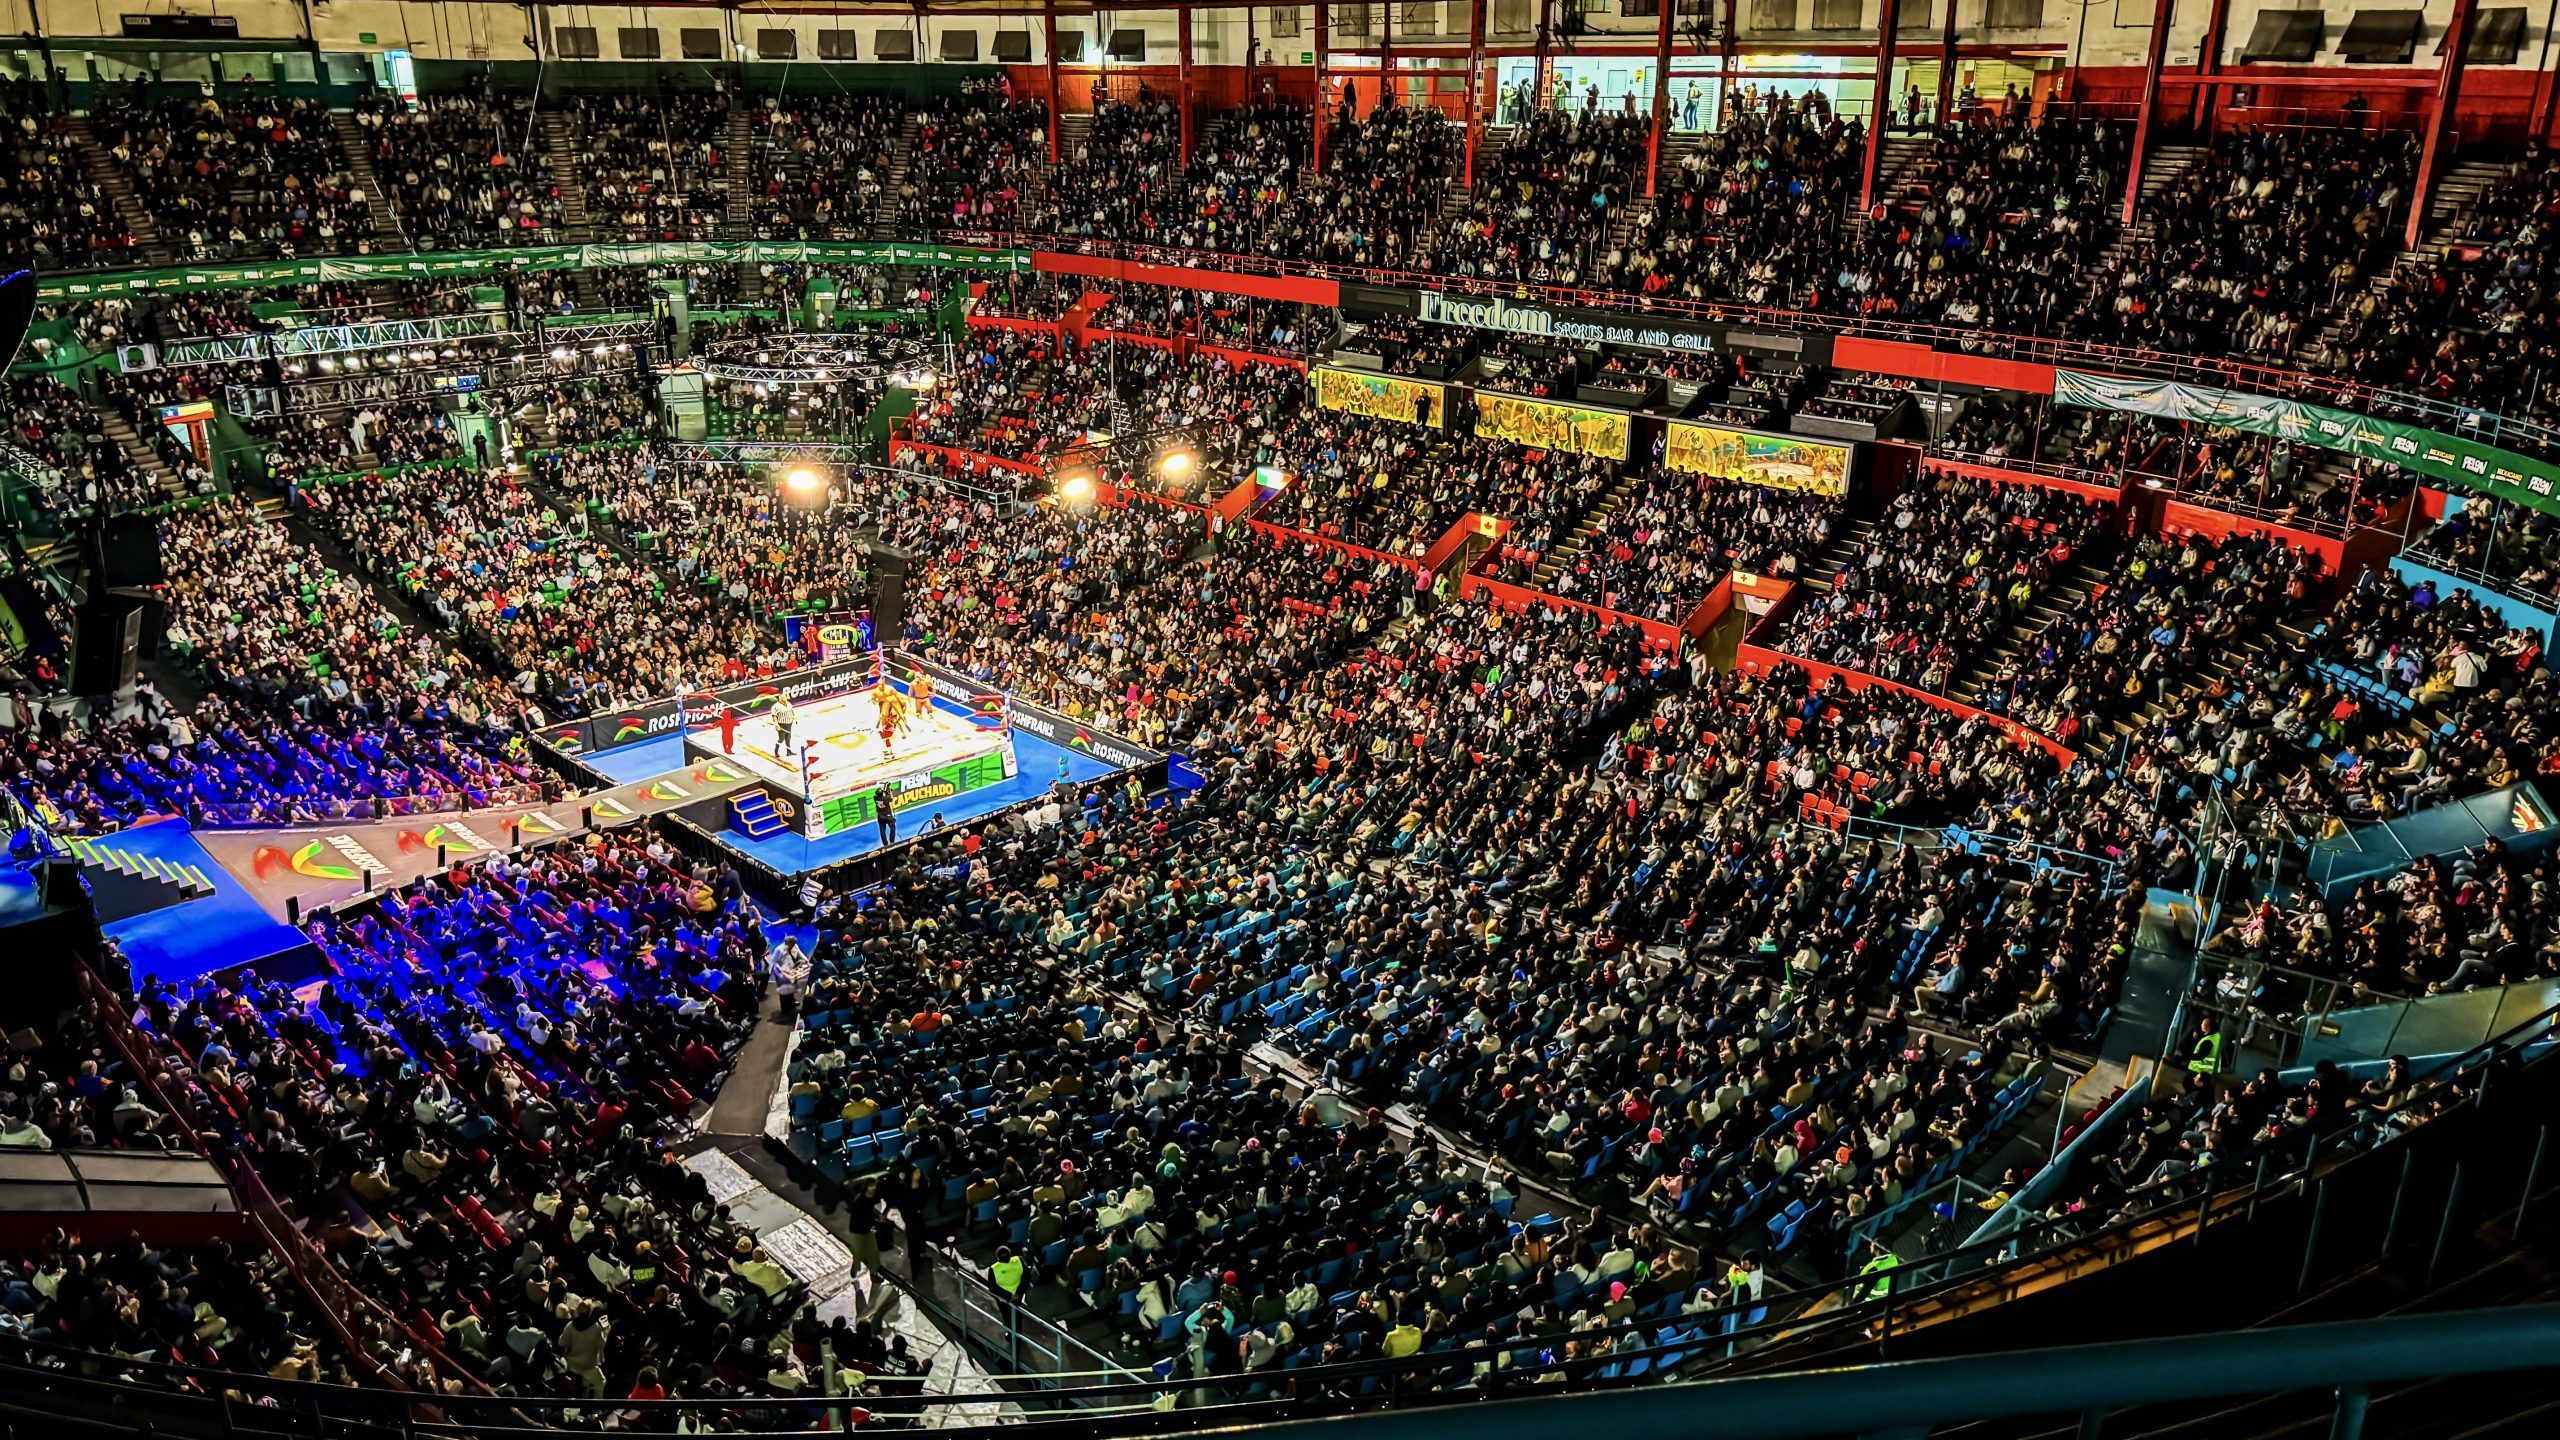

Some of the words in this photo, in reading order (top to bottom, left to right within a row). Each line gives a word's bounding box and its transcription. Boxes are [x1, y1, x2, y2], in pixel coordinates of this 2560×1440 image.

[1417, 290, 1551, 335] Freedom
[1554, 321, 1603, 339] SPORTS
[1606, 326, 1635, 343] BAR
[1637, 330, 1669, 347] AND
[1672, 334, 1715, 351] GRILL
[1011, 709, 1055, 738] OSHFRANS
